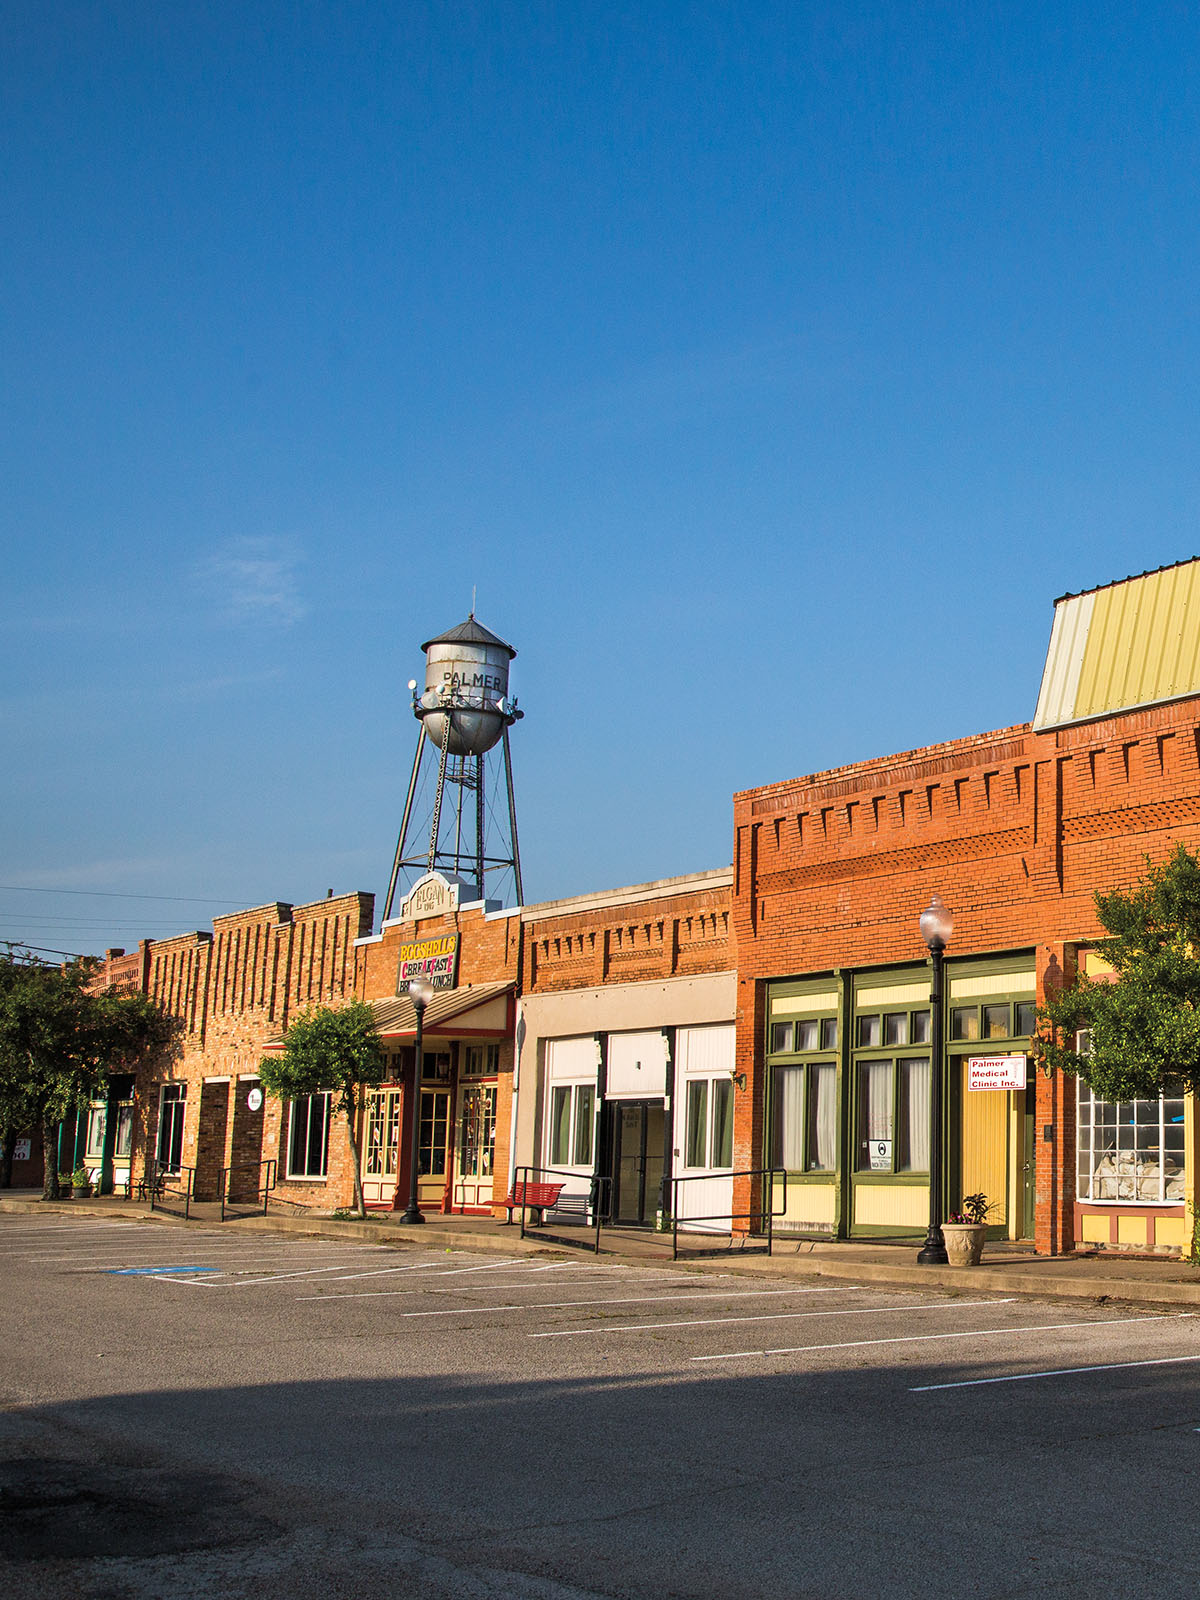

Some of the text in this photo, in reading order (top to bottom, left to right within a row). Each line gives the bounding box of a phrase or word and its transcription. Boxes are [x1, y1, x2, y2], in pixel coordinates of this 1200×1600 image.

[443, 672, 501, 690] PALMER
[400, 936, 456, 961] EGGSHELLS
[972, 1070, 1008, 1078] Medical
